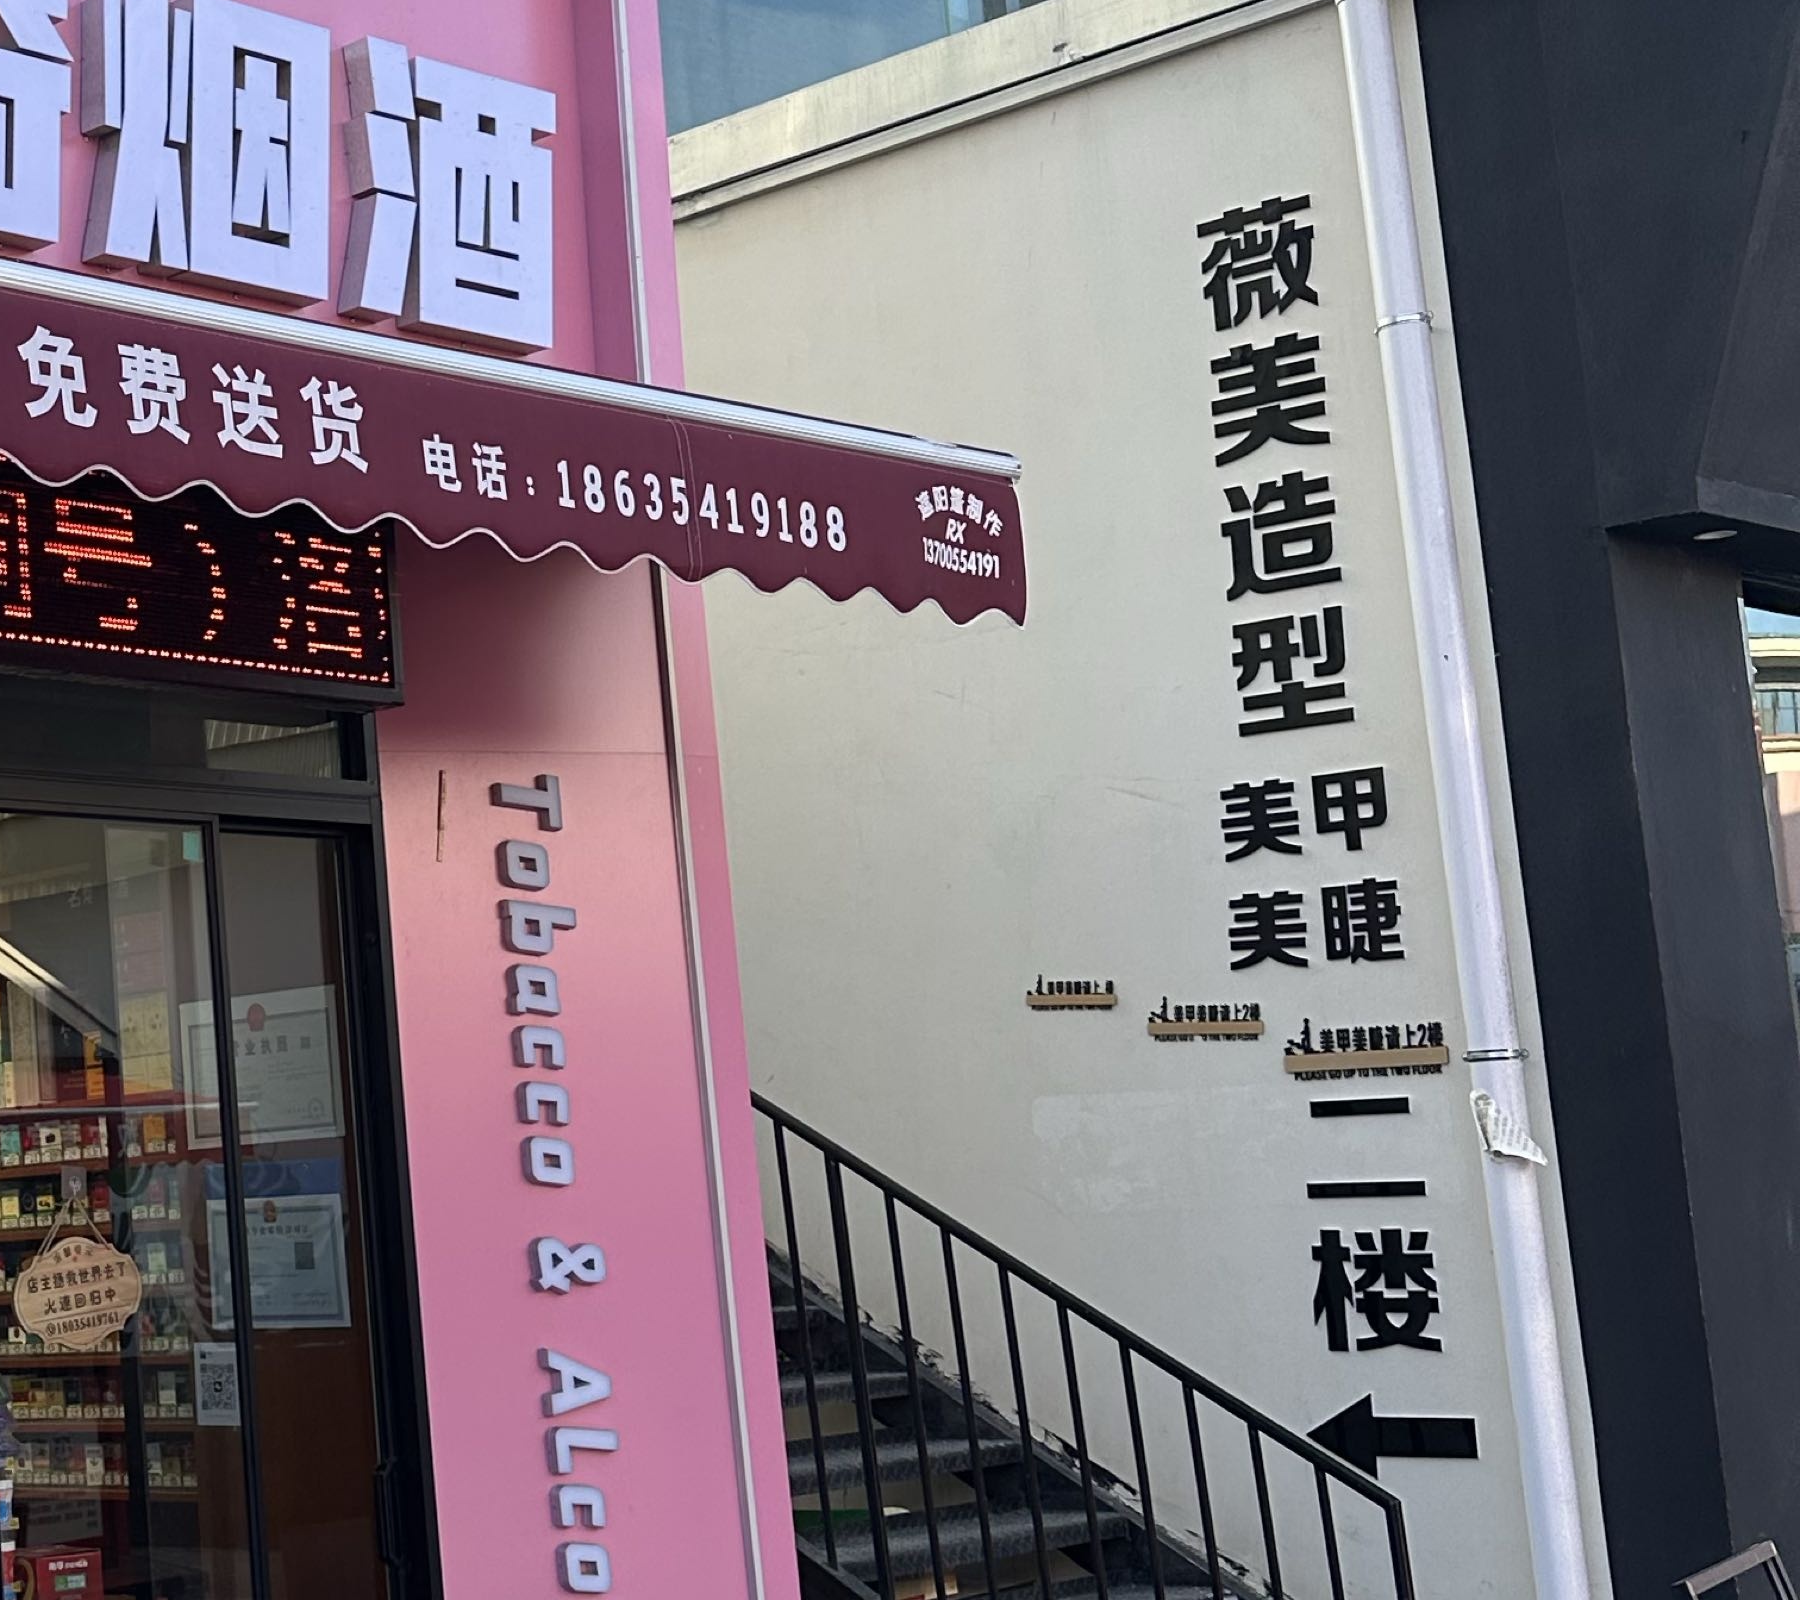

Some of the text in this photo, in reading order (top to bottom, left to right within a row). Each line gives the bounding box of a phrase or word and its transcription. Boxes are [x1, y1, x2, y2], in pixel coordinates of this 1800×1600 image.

[17, 325, 369, 473] 免费送货
[1197, 193, 1355, 737] 薇美造型
[922, 537, 1000, 579] 13700554191
[945, 518, 967, 544] RX
[1221, 767, 1388, 863] 美甲
[1229, 878, 1406, 971] 美睫
[490, 774, 576, 1188] Tobacco
[530, 1237, 607, 1294] &
[1306, 1096, 1444, 1354] 二楼
